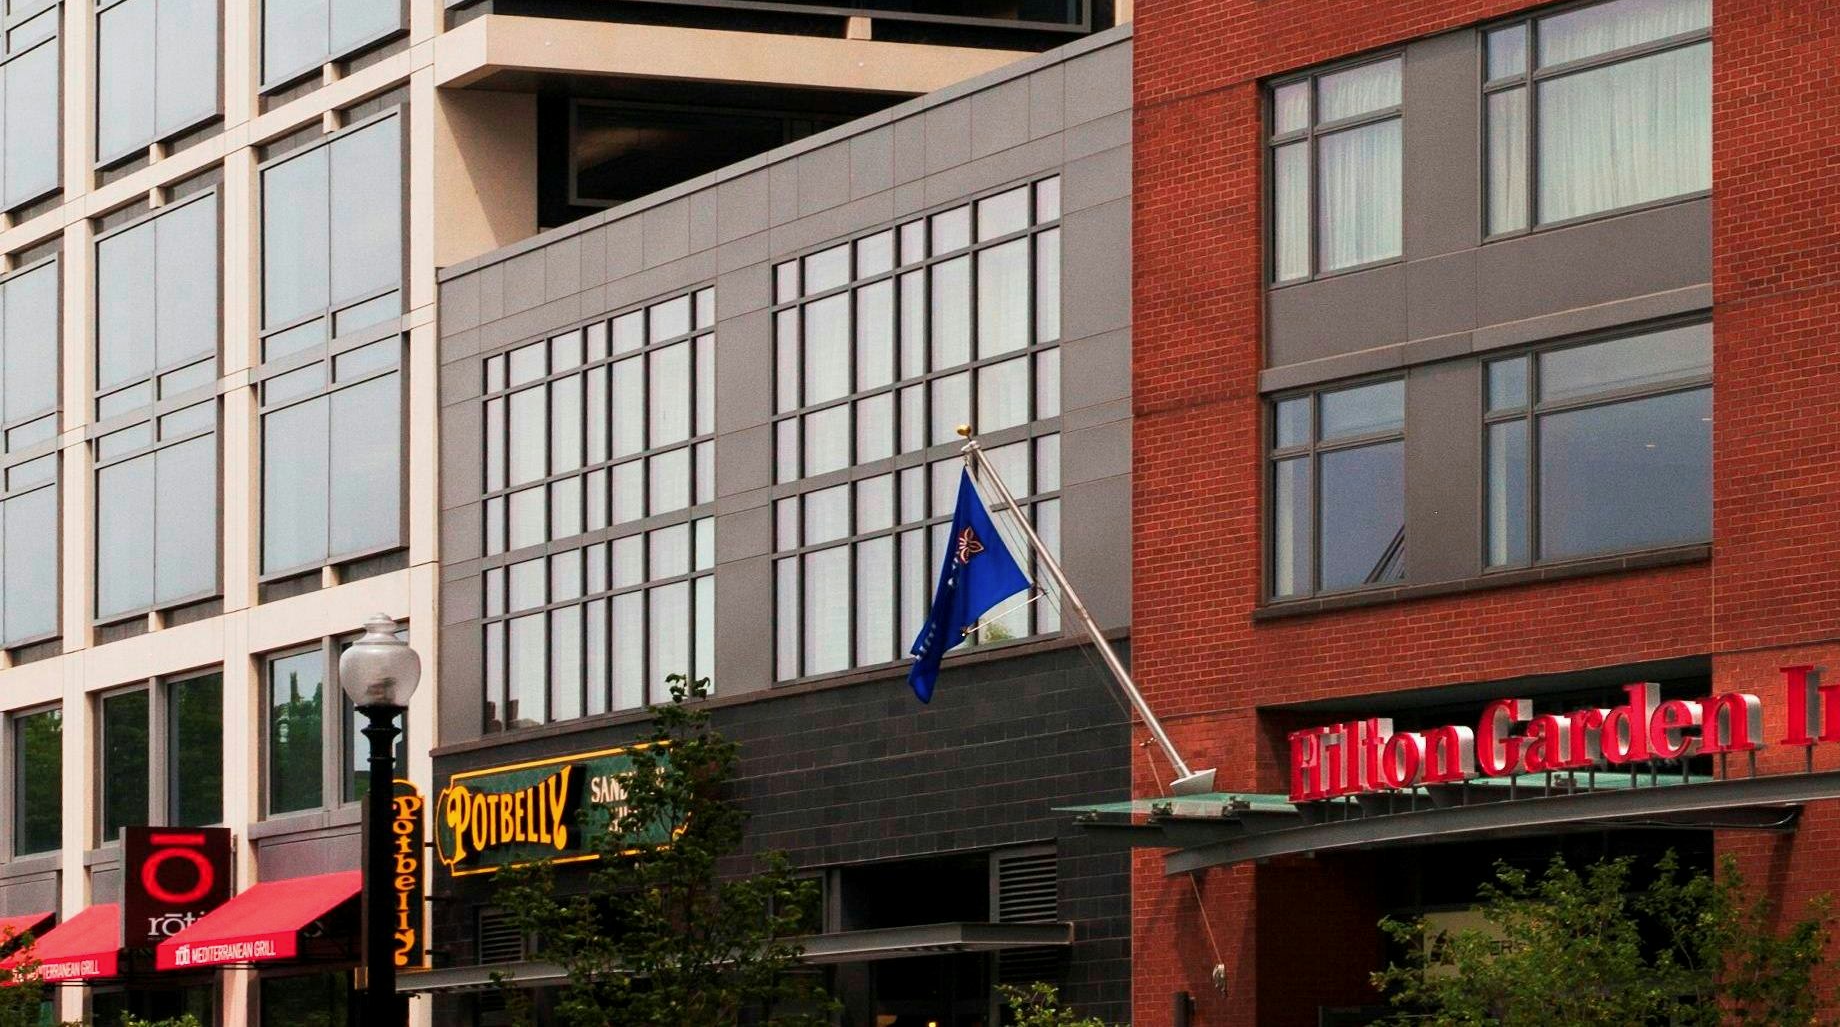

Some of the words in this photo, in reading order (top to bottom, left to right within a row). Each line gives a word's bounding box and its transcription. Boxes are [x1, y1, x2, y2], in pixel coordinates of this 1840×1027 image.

[1288, 717, 1479, 803] Hilton
[1476, 682, 1766, 777] Garden
[446, 764, 572, 864] POTBELLY
[191, 942, 253, 964] MEDITERRANEAN
[254, 938, 276, 957] GRILL
